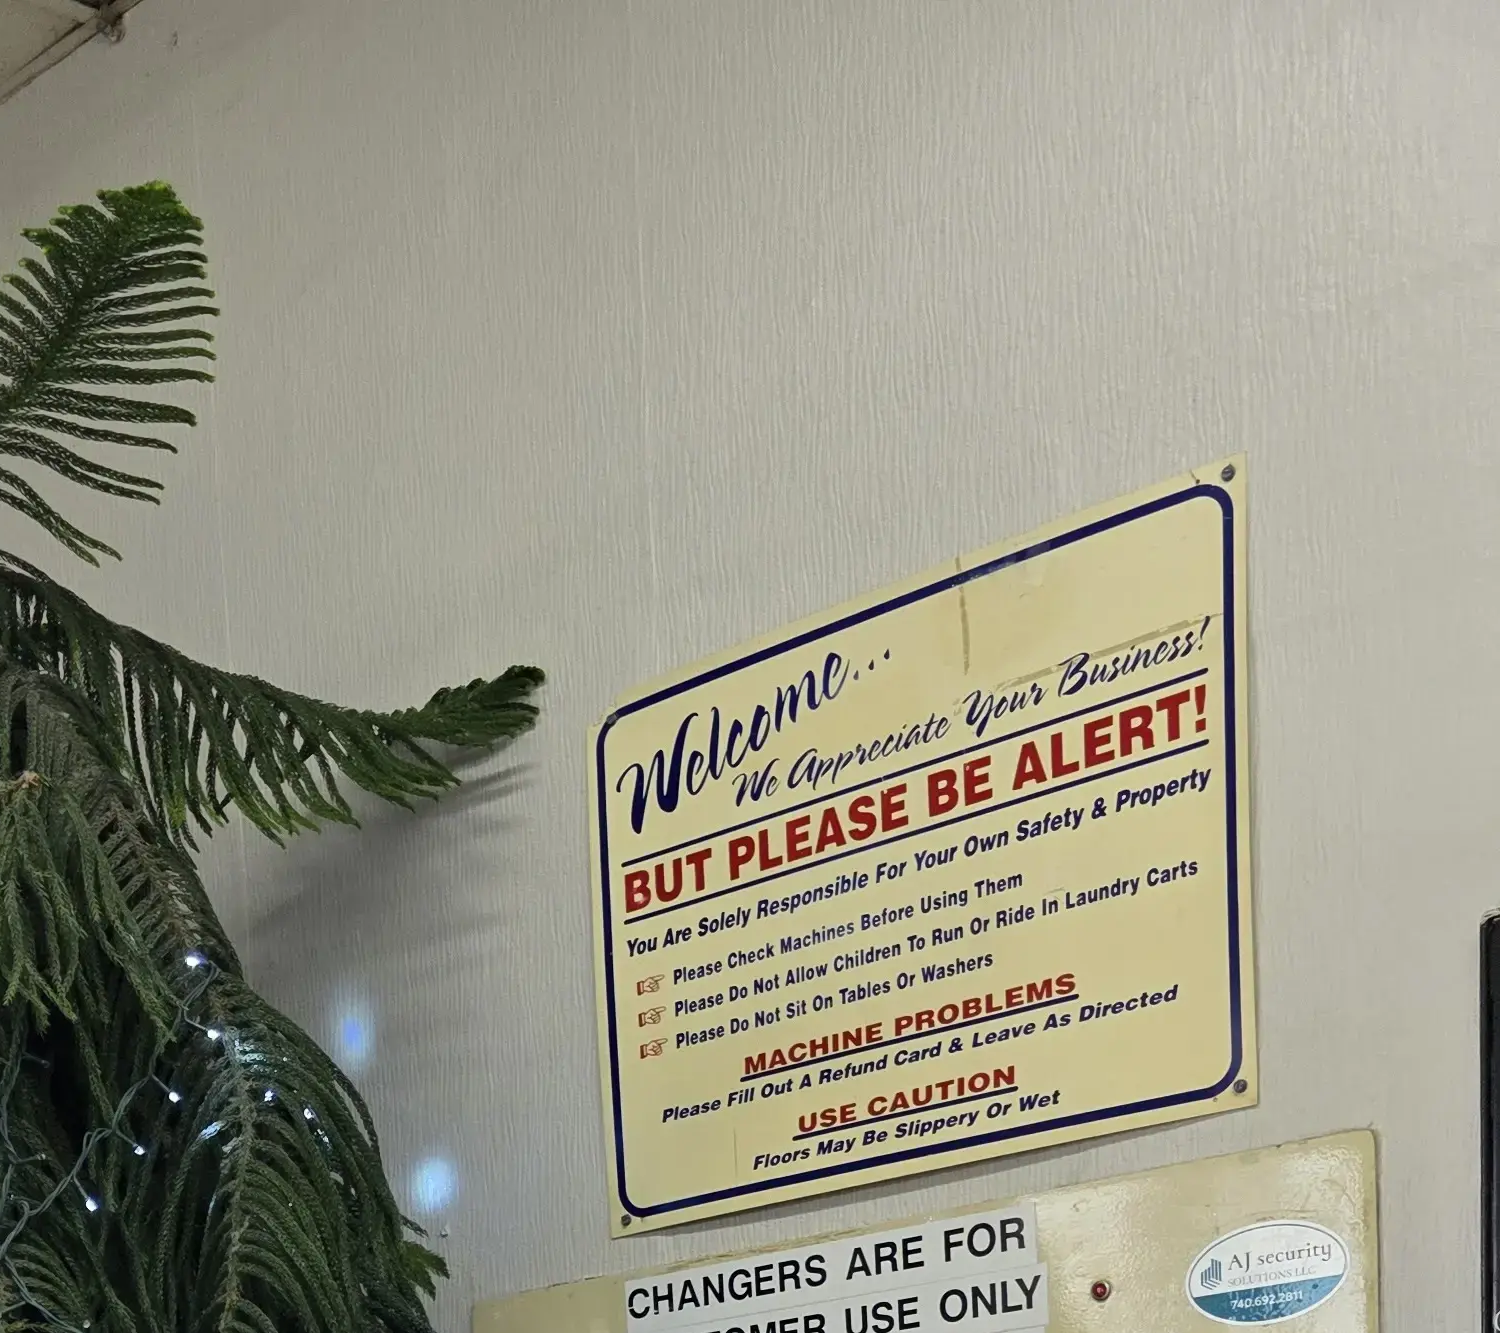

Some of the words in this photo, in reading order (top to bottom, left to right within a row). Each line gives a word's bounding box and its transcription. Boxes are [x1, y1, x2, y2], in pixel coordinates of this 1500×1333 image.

[732, 758, 780, 806] We
[787, 713, 951, 790] Appreciate
[962, 682, 1049, 738] Your
[1058, 615, 1211, 697] Business!
[624, 848, 712, 913] BUT
[728, 783, 909, 881] PLEASE
[927, 755, 993, 817] BE
[1012, 684, 1206, 791] ALERT!
[626, 937, 657, 957] You
[663, 924, 692, 948] Are
[697, 906, 751, 937] Solely
[756, 871, 868, 919] Responsible
[875, 860, 907, 883] For
[914, 846, 958, 872] Your
[964, 830, 1009, 857] Own
[1016, 807, 1085, 841] Safety
[1091, 797, 1107, 819] &
[1115, 768, 1211, 812] Property
[673, 961, 722, 985] Please
[727, 942, 775, 969] Check
[780, 921, 854, 954] Machines
[861, 902, 914, 931] Before
[920, 888, 968, 914] Using
[974, 873, 1023, 898] Them
[674, 992, 723, 1017] Please
[729, 985, 748, 1002] Do
[753, 974, 780, 996] Not
[785, 962, 828, 987] Allow
[834, 942, 901, 972] Children
[907, 934, 926, 952] To
[932, 924, 963, 947] Run
[970, 917, 989, 935] Or
[996, 905, 1035, 928] Ride
[1042, 898, 1058, 916] In
[1065, 875, 1140, 909] Laundry
[1147, 860, 1198, 887] Carts
[676, 1024, 725, 1049] Please
[730, 1017, 749, 1034] Do
[755, 1006, 781, 1028] Not
[786, 999, 807, 1020] Sit
[813, 994, 833, 1012] On
[839, 979, 891, 1005] Tables
[897, 972, 916, 990] Or
[921, 953, 993, 984] Washers
[743, 1021, 883, 1075] MACHINE
[894, 973, 1076, 1037] PROBLEMS
[662, 1099, 721, 1123] Please
[727, 1087, 755, 1107] Fill
[760, 1078, 794, 1099] Out
[798, 1074, 812, 1090] A
[818, 1054, 888, 1085] Refund
[894, 1042, 942, 1066] Card
[948, 1037, 963, 1053] &
[971, 1022, 1036, 1048] Leave
[1042, 1013, 1071, 1031] As
[1078, 984, 1178, 1023] Directed
[798, 1102, 857, 1133] USE
[866, 1065, 1016, 1116] CAUTION
[753, 1149, 810, 1170] Floors
[816, 1136, 855, 1156] May
[862, 1130, 888, 1146] Be
[894, 1110, 979, 1138] Slippery
[986, 1102, 1012, 1119] Or
[1018, 1089, 1061, 1112] Wet
[627, 1254, 827, 1320] CHANGERS
[846, 1235, 925, 1281] ARE
[943, 1216, 1026, 1262] FOR
[939, 1274, 1041, 1323] ONLY
[1227, 1251, 1252, 1273] AJ
[1257, 1242, 1332, 1266] security
[1227, 1268, 1293, 1288] SOLUTIONS
[1295, 1265, 1317, 1276] LLC
